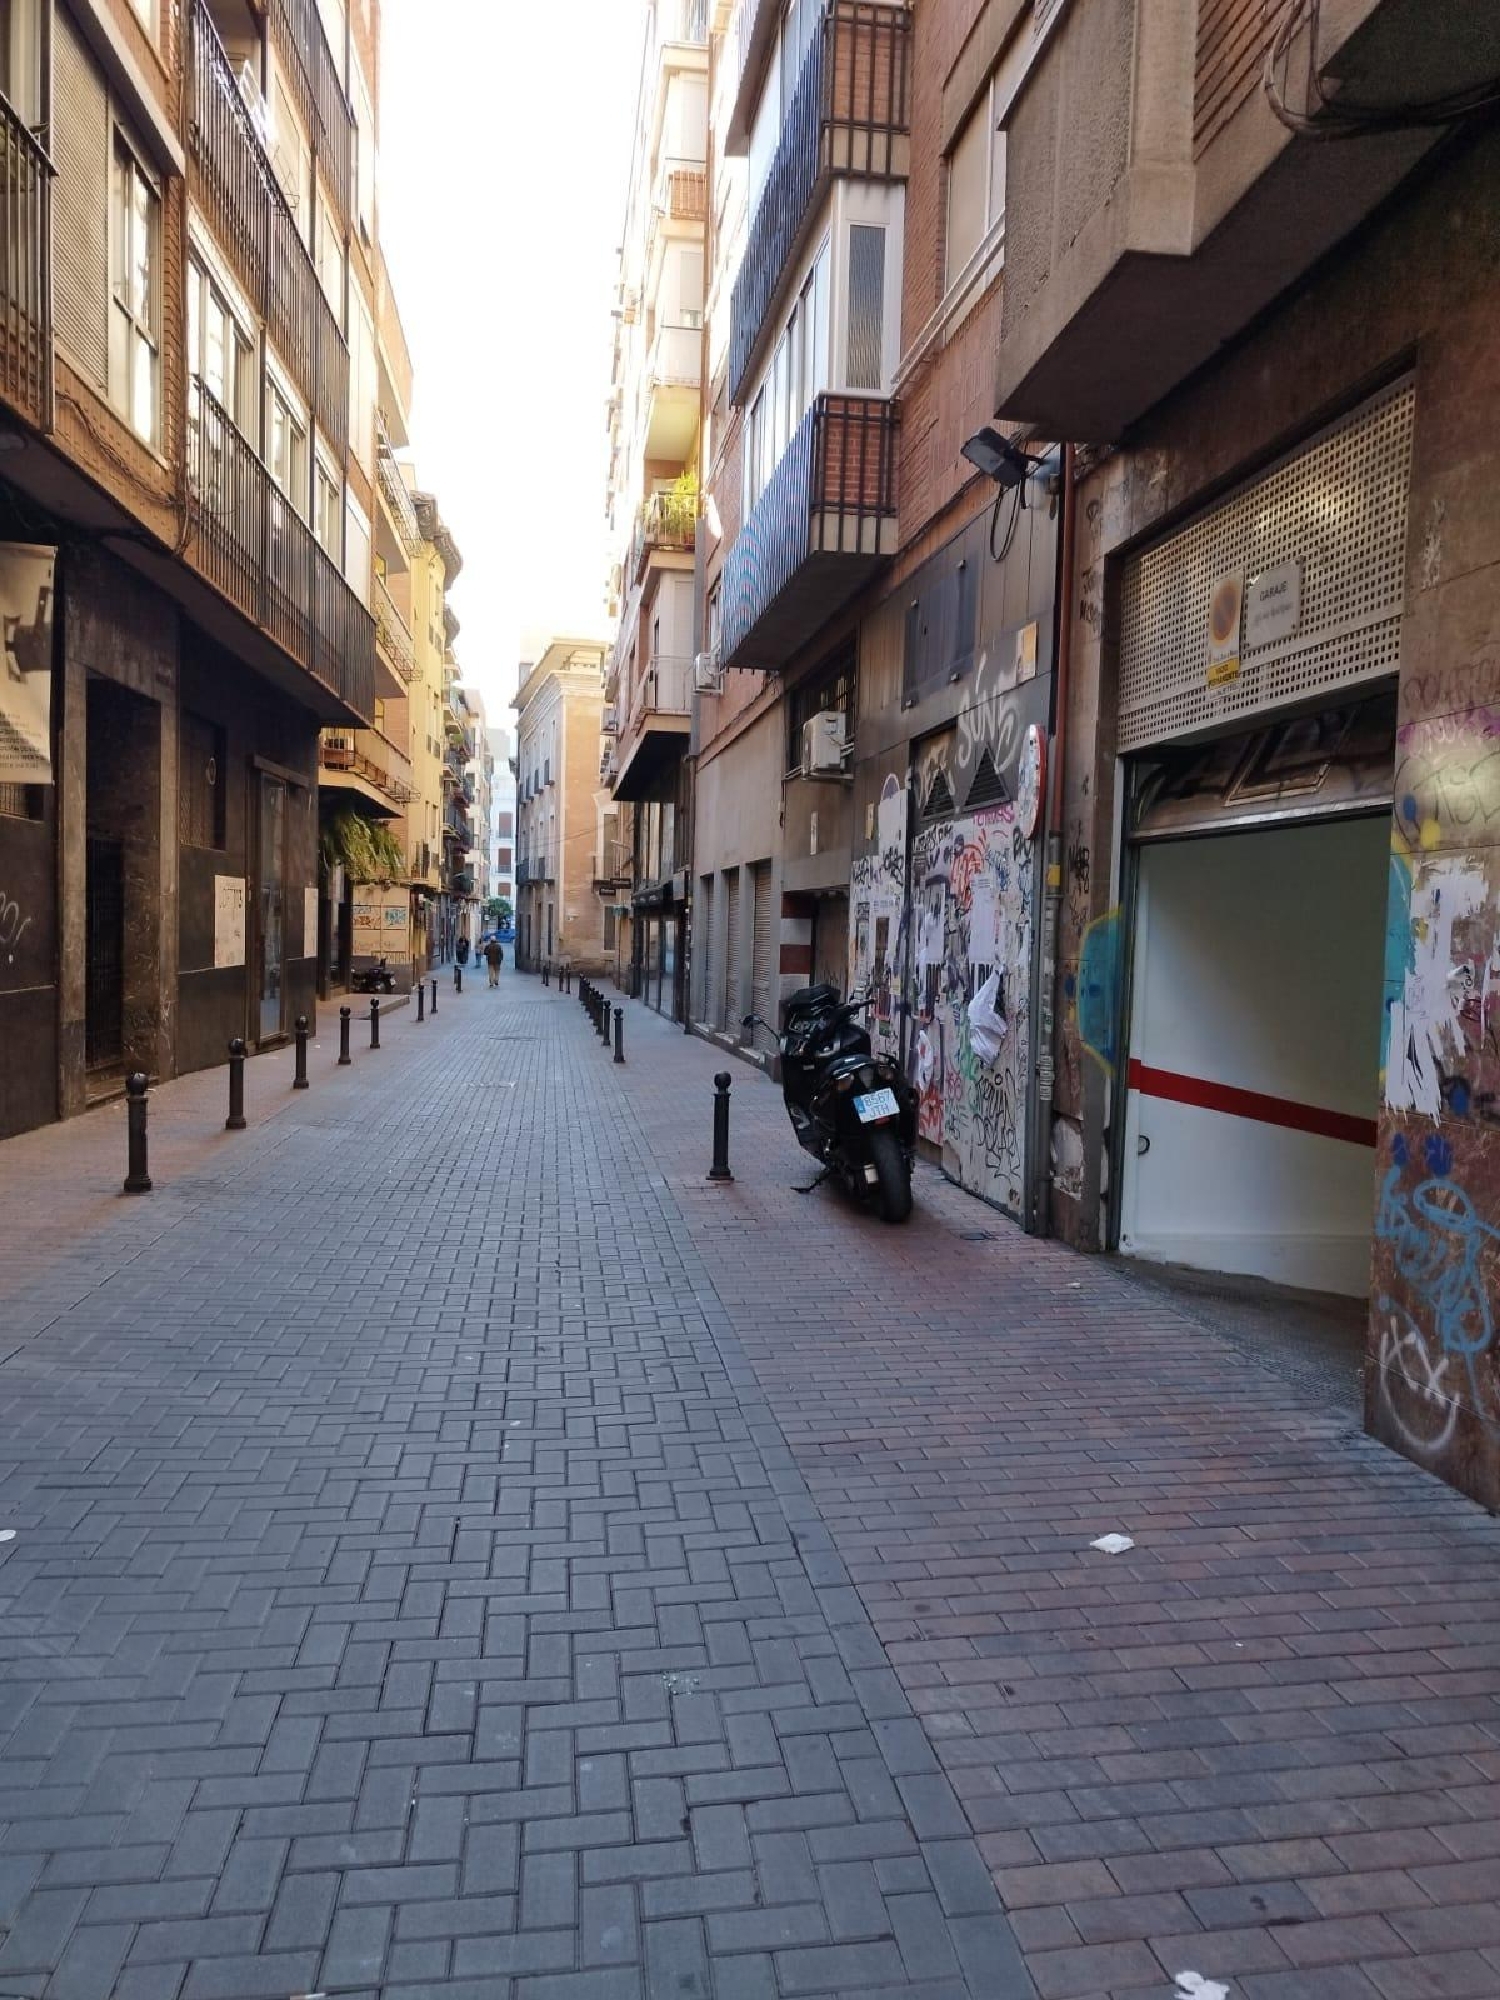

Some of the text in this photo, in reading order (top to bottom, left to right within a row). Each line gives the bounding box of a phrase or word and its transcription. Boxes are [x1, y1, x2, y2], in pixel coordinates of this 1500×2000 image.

[1259, 581, 1288, 601] GARAJE
[863, 1089, 891, 1107] 8567
[869, 1103, 891, 1119] JTH
